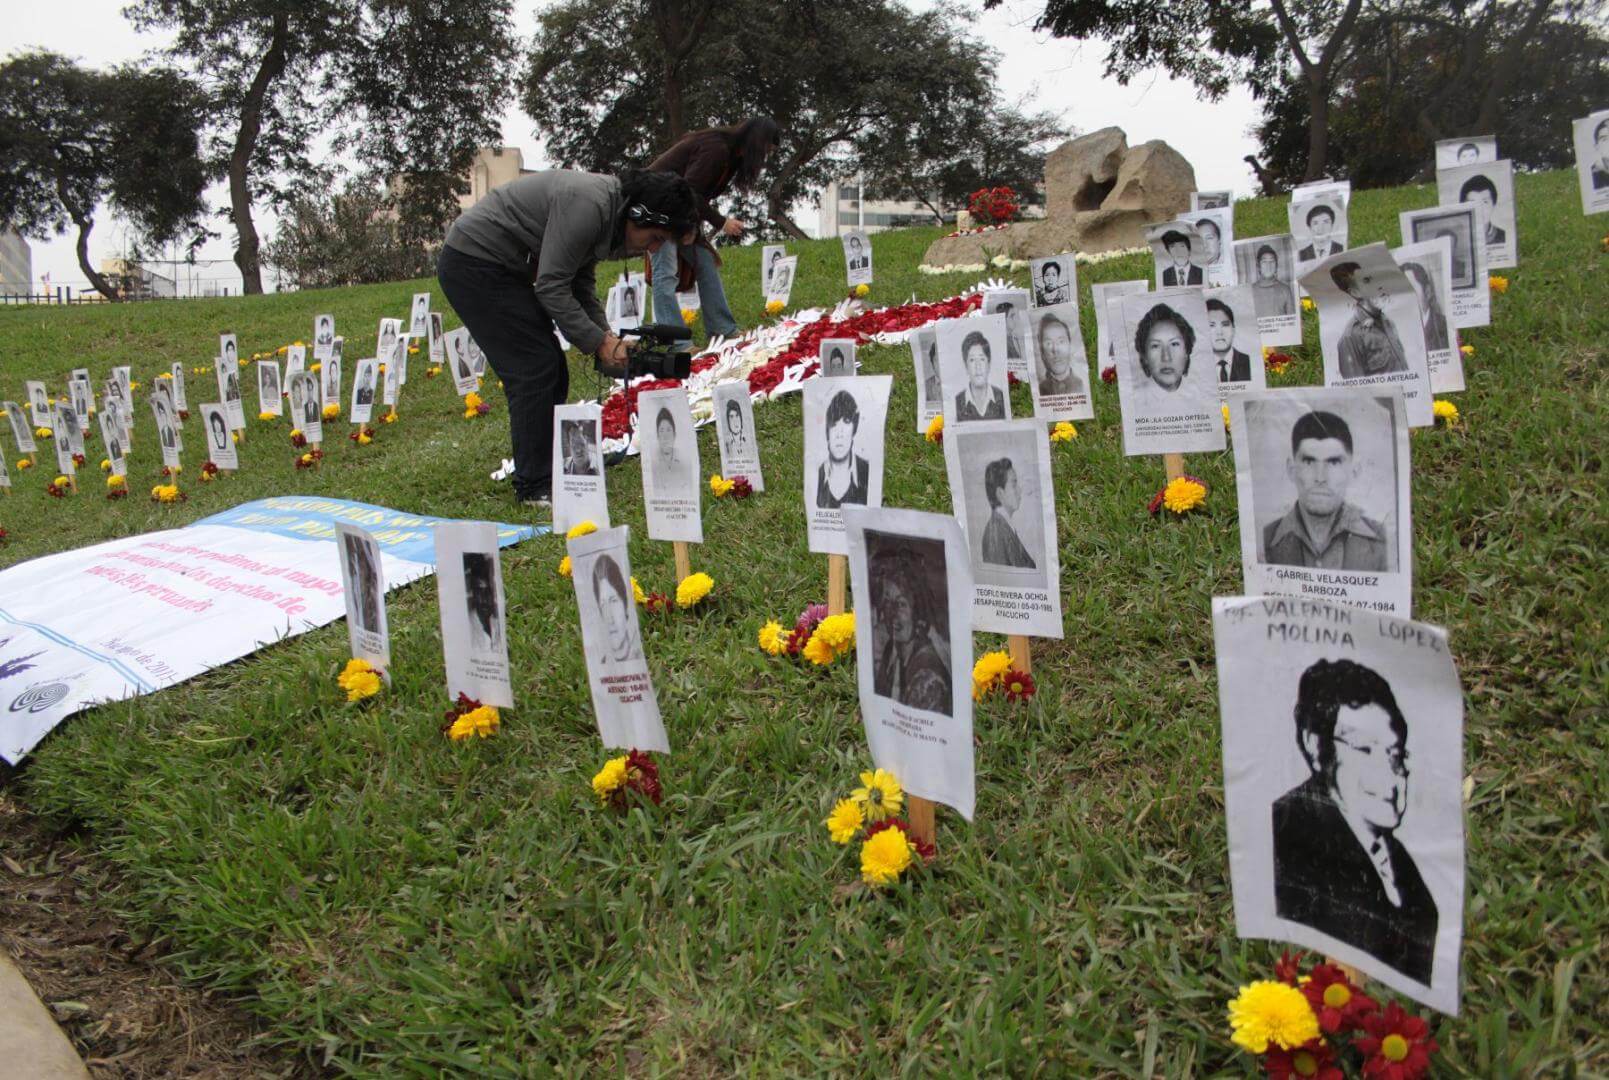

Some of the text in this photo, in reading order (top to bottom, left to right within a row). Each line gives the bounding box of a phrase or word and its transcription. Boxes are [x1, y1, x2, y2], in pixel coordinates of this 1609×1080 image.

[1387, 372, 1420, 383] ARTEAGA
[1184, 413, 1210, 421] ORTEGA
[1276, 569, 1379, 587] GABRIEL VELASQUEZ
[1024, 592, 1048, 602] OCHOA
[1301, 584, 1348, 597] BARBOZA
[273, 594, 308, 617] de
[995, 609, 1030, 620] AYACUCHO
[1262, 600, 1352, 624] VALENTIN
[1378, 619, 1443, 653] LOPEZ
[1267, 623, 1356, 650] MOLINA
